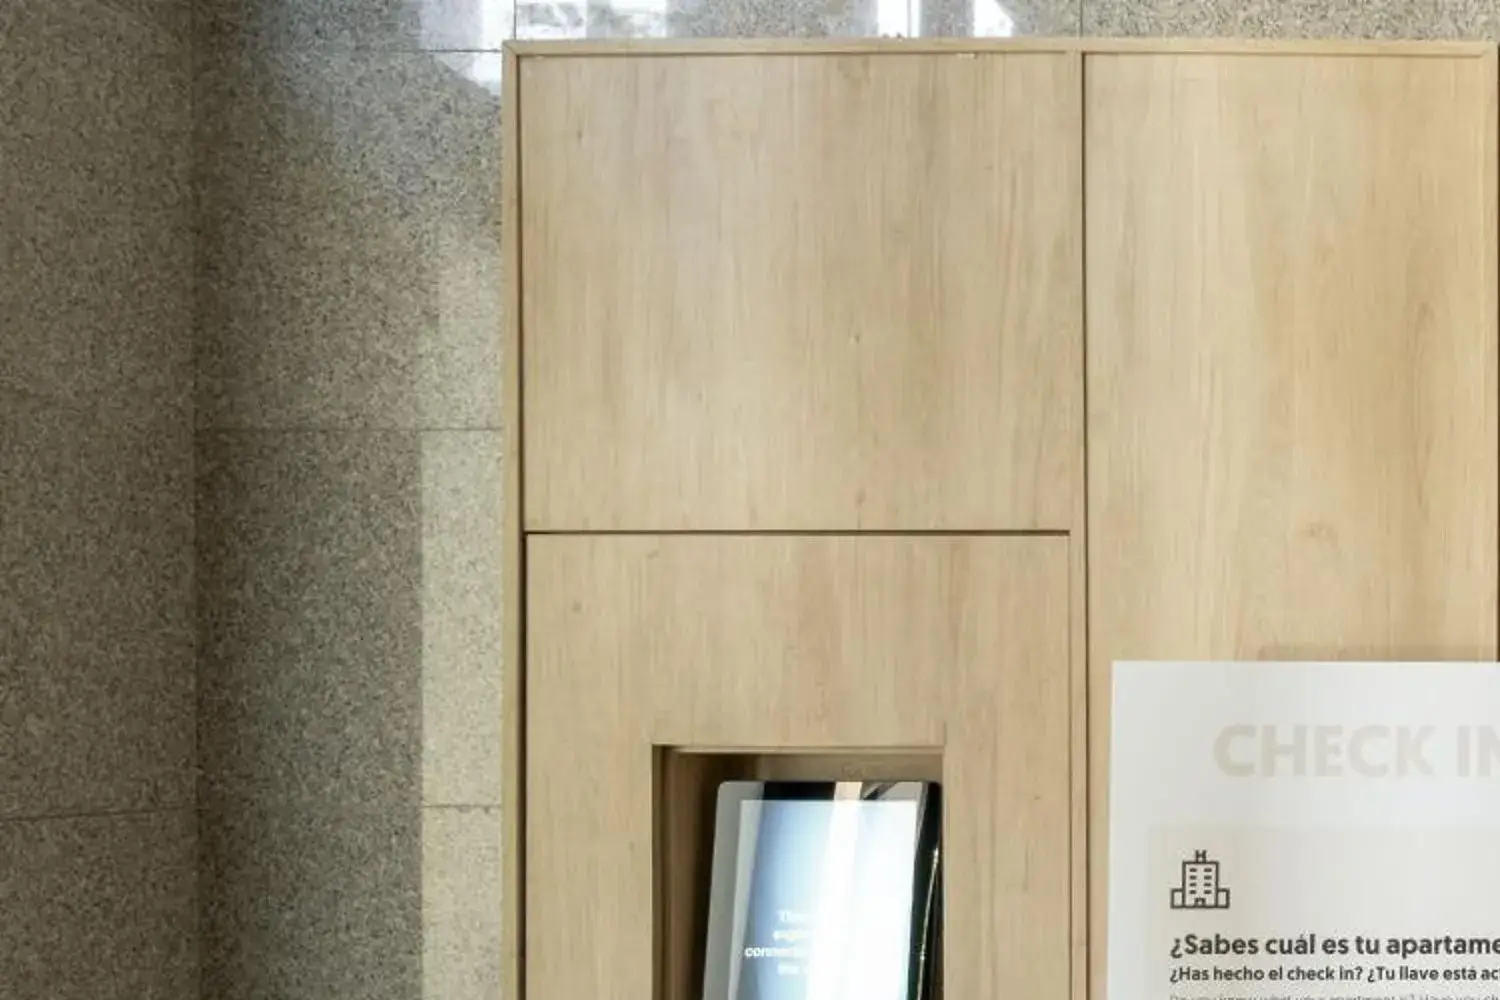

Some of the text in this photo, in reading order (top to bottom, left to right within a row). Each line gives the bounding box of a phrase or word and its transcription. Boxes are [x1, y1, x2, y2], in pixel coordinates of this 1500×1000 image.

[1213, 725, 1438, 778] CHECK
[1170, 933, 1259, 959] ¿Sabes
[1265, 933, 1315, 955] cuál
[1322, 938, 1349, 955] es
[1355, 936, 1380, 955] tu
[1170, 966, 1209, 983] ¿Has
[1214, 966, 1264, 981] hecho
[1269, 966, 1283, 981] el
[1287, 966, 1334, 981] check
[1339, 966, 1363, 981] in?
[1368, 966, 1395, 983] ¿Tu
[1400, 966, 1438, 981] llave
[1443, 966, 1477, 981] está
